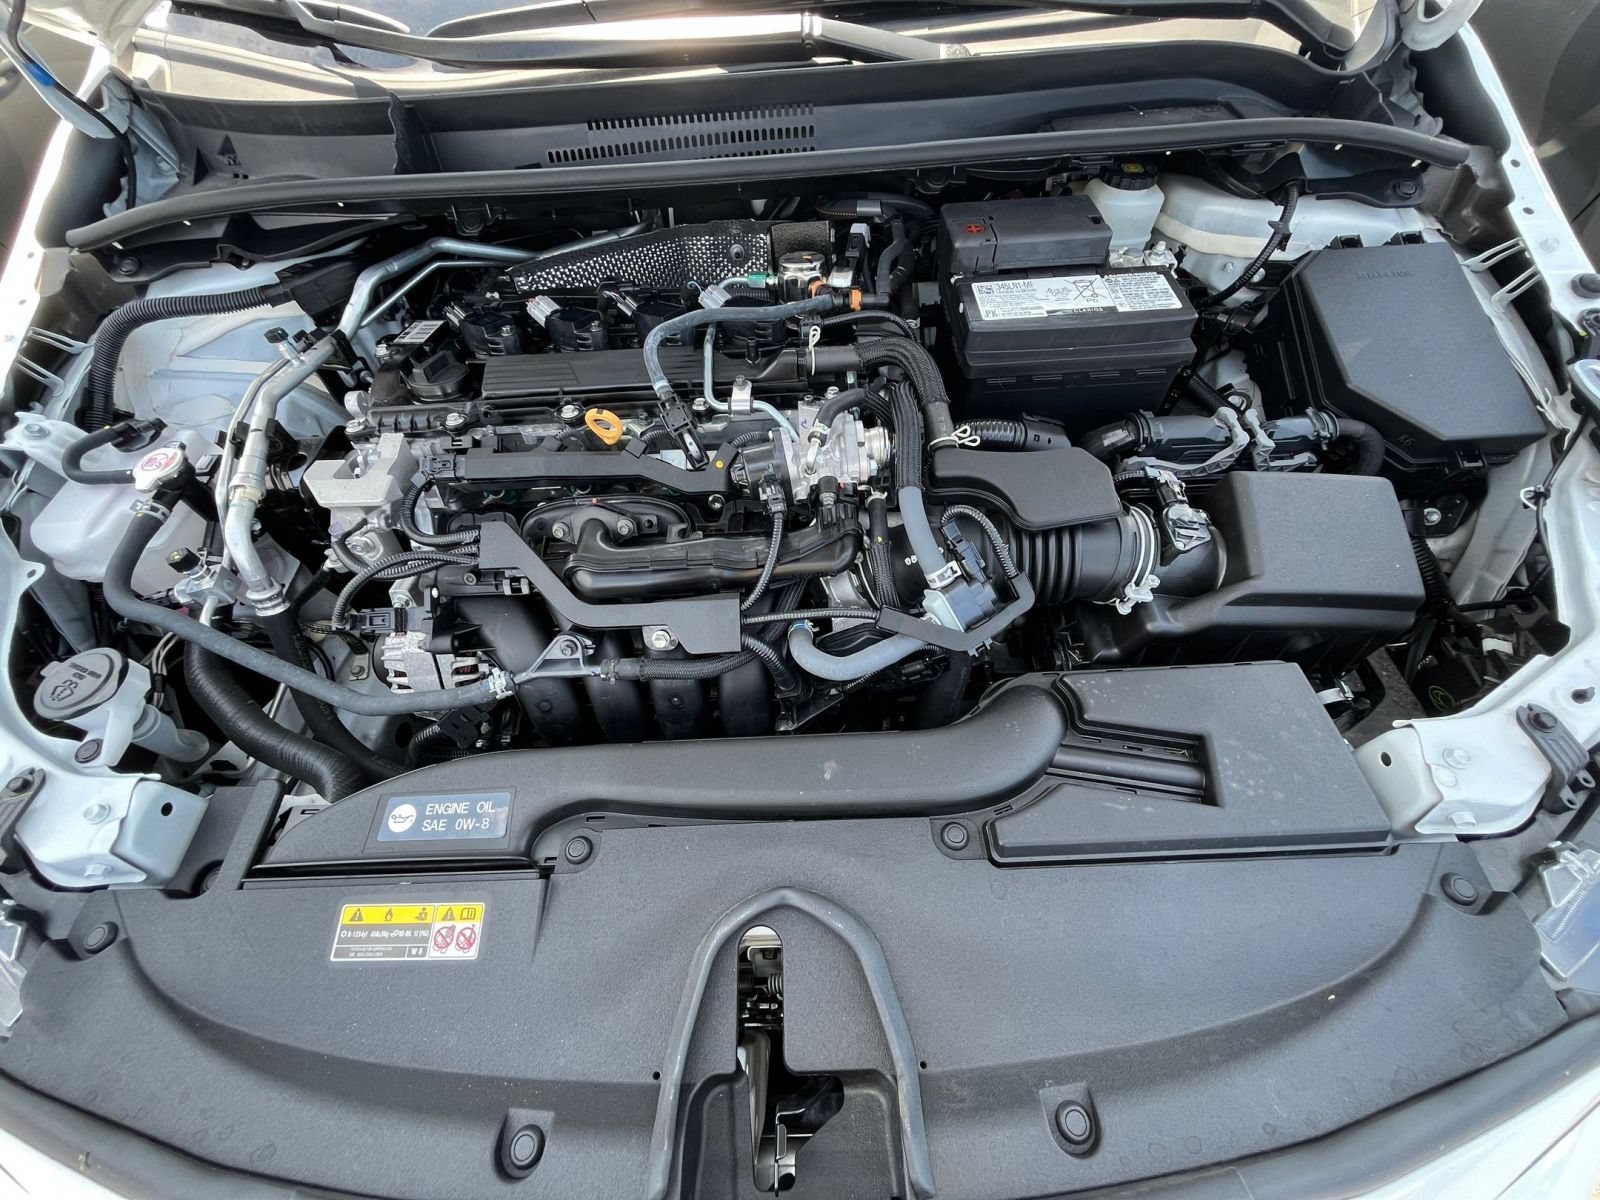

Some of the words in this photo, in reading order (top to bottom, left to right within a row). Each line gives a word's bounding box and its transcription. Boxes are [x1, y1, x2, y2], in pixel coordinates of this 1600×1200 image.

[425, 802, 470, 816] ENGINE
[476, 801, 496, 814] OIL
[421, 819, 447, 832] SAE
[455, 818, 490, 831] 0W-8
